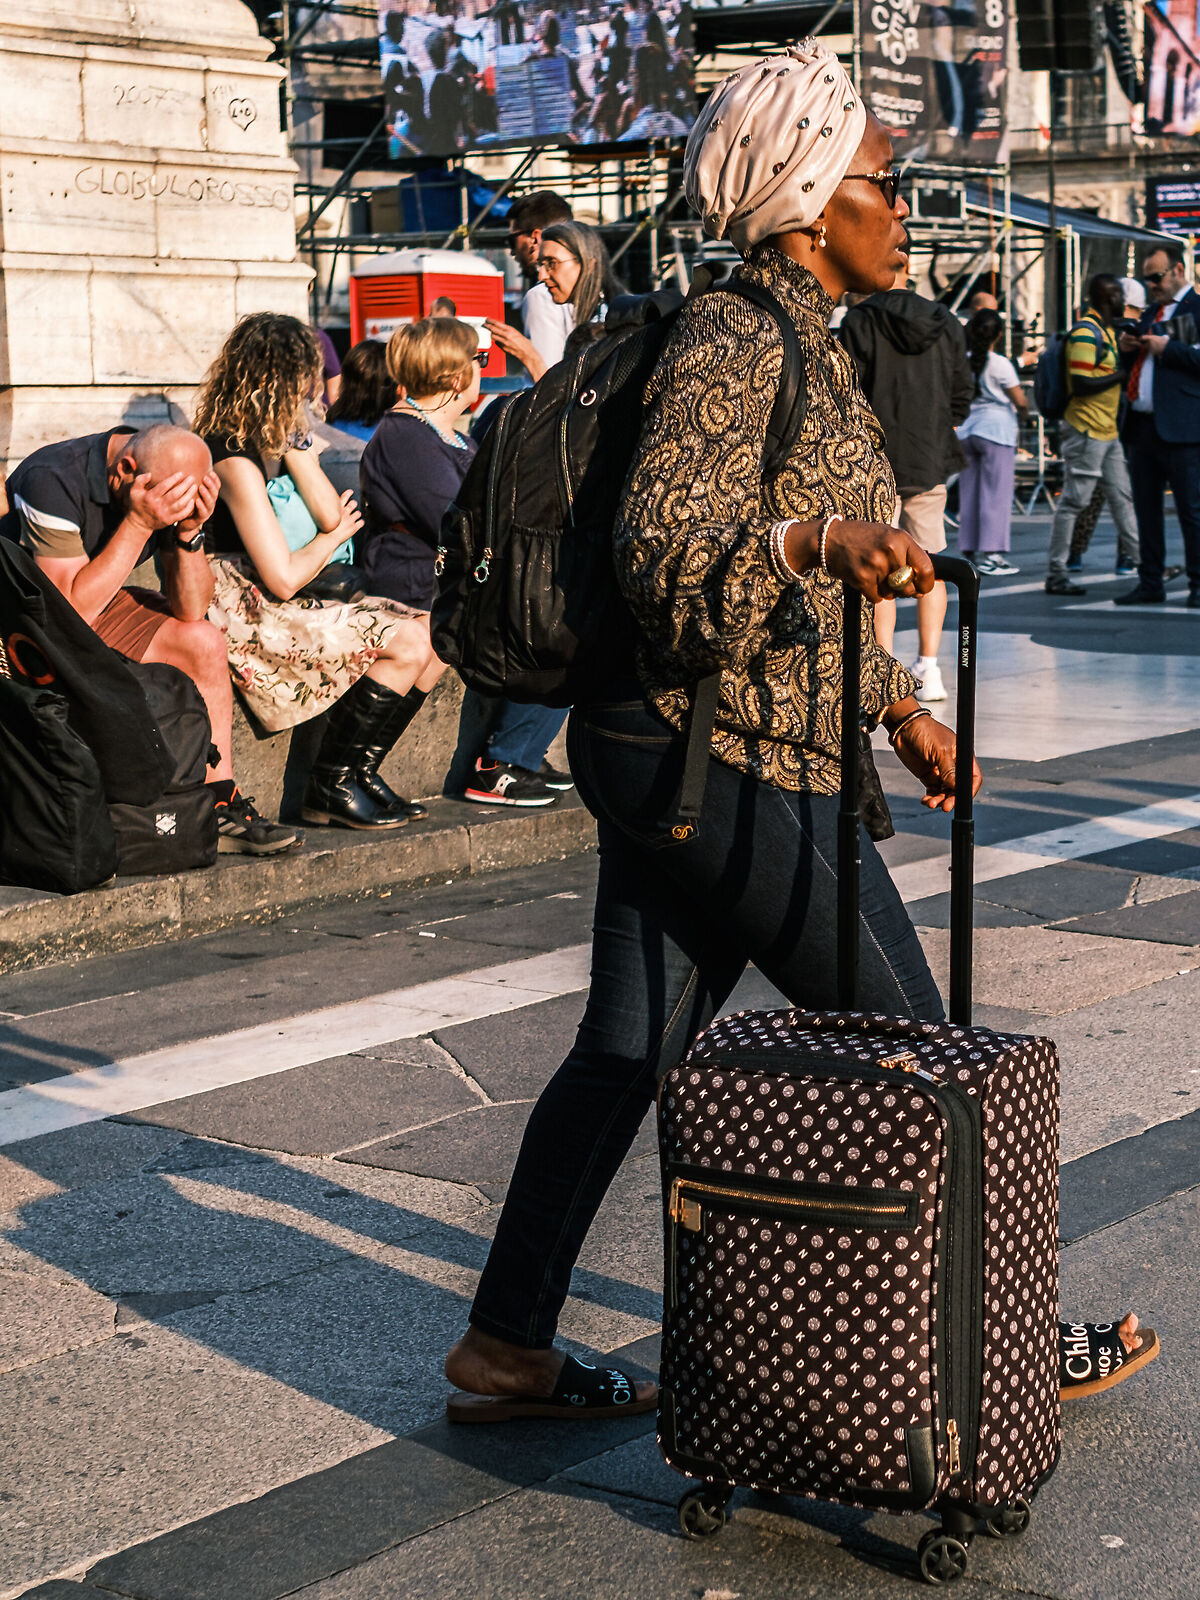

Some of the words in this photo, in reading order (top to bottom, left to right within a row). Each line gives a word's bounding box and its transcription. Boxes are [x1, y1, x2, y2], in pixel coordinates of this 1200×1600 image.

[874, 31, 908, 65] TO
[962, 625, 970, 647] 100%
[961, 647, 969, 668] DKNY
